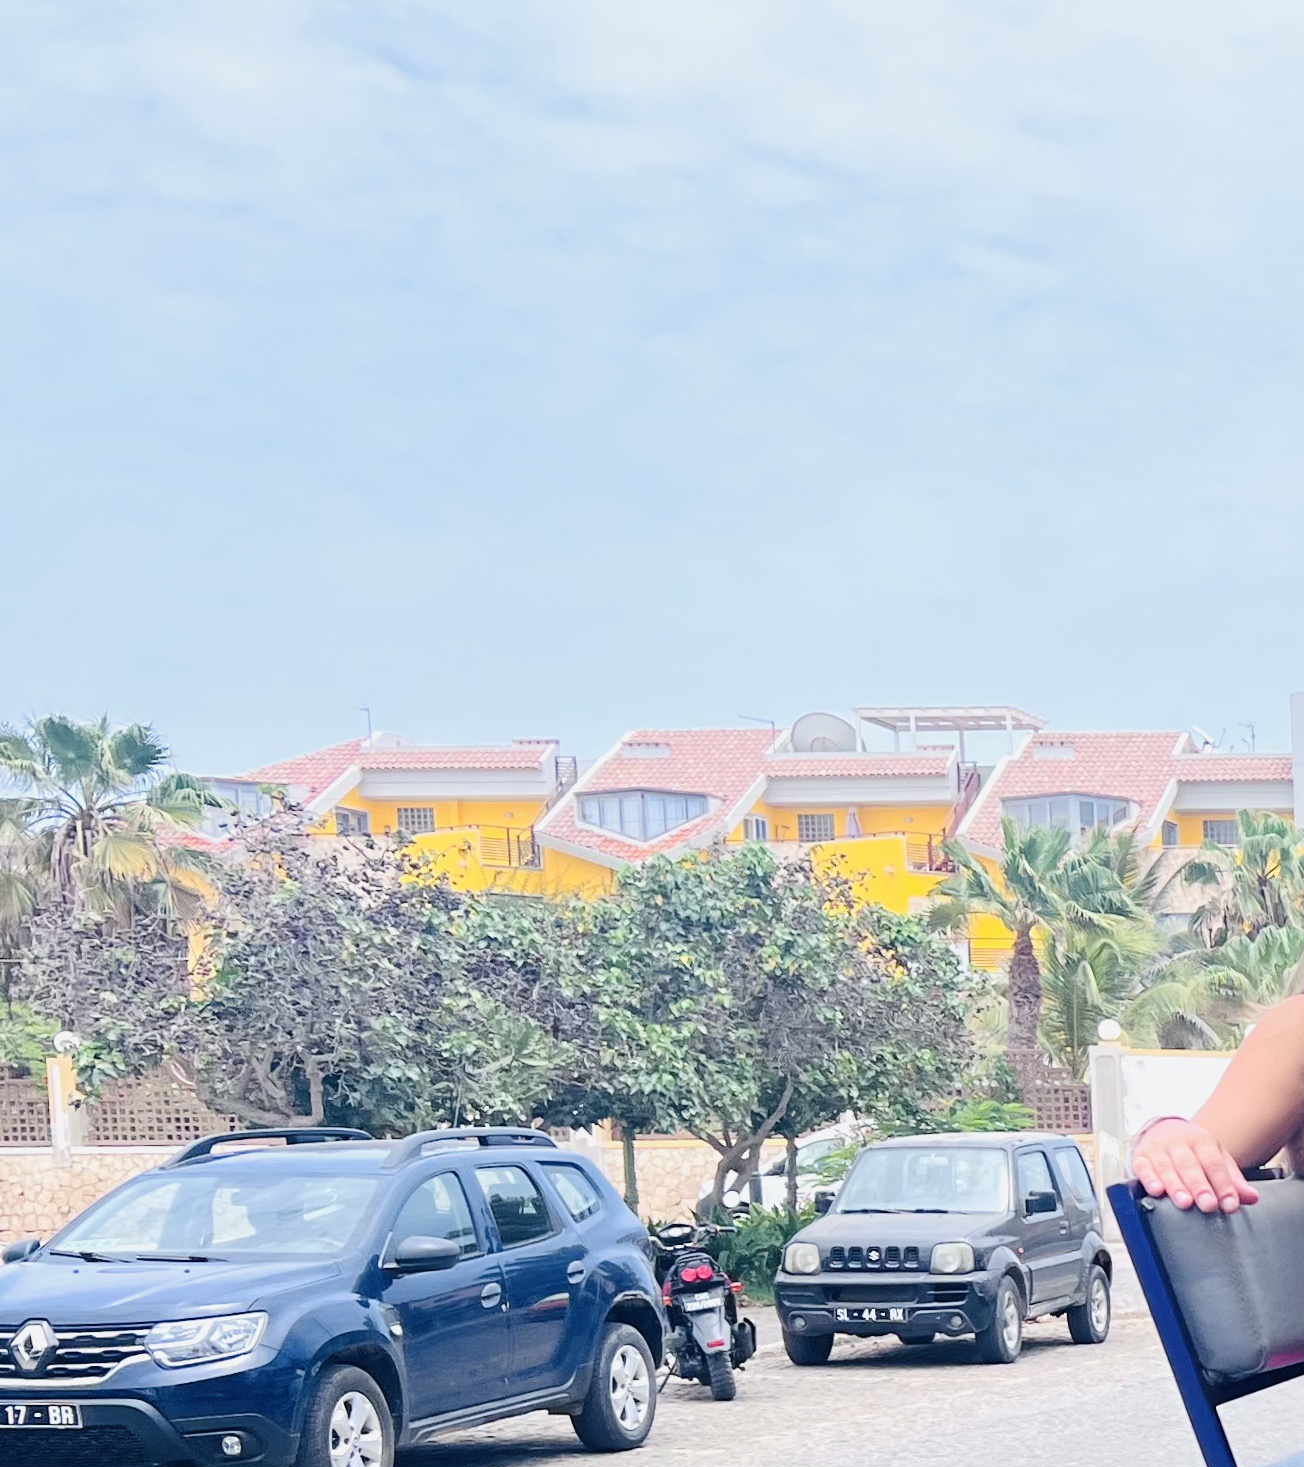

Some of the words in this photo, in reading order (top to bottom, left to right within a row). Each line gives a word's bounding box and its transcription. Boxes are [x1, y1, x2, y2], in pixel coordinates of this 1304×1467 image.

[836, 1308, 850, 1321] SL
[862, 1308, 877, 1321] 44
[4, 1405, 27, 1425] 17
[48, 1405, 75, 1425] BR
